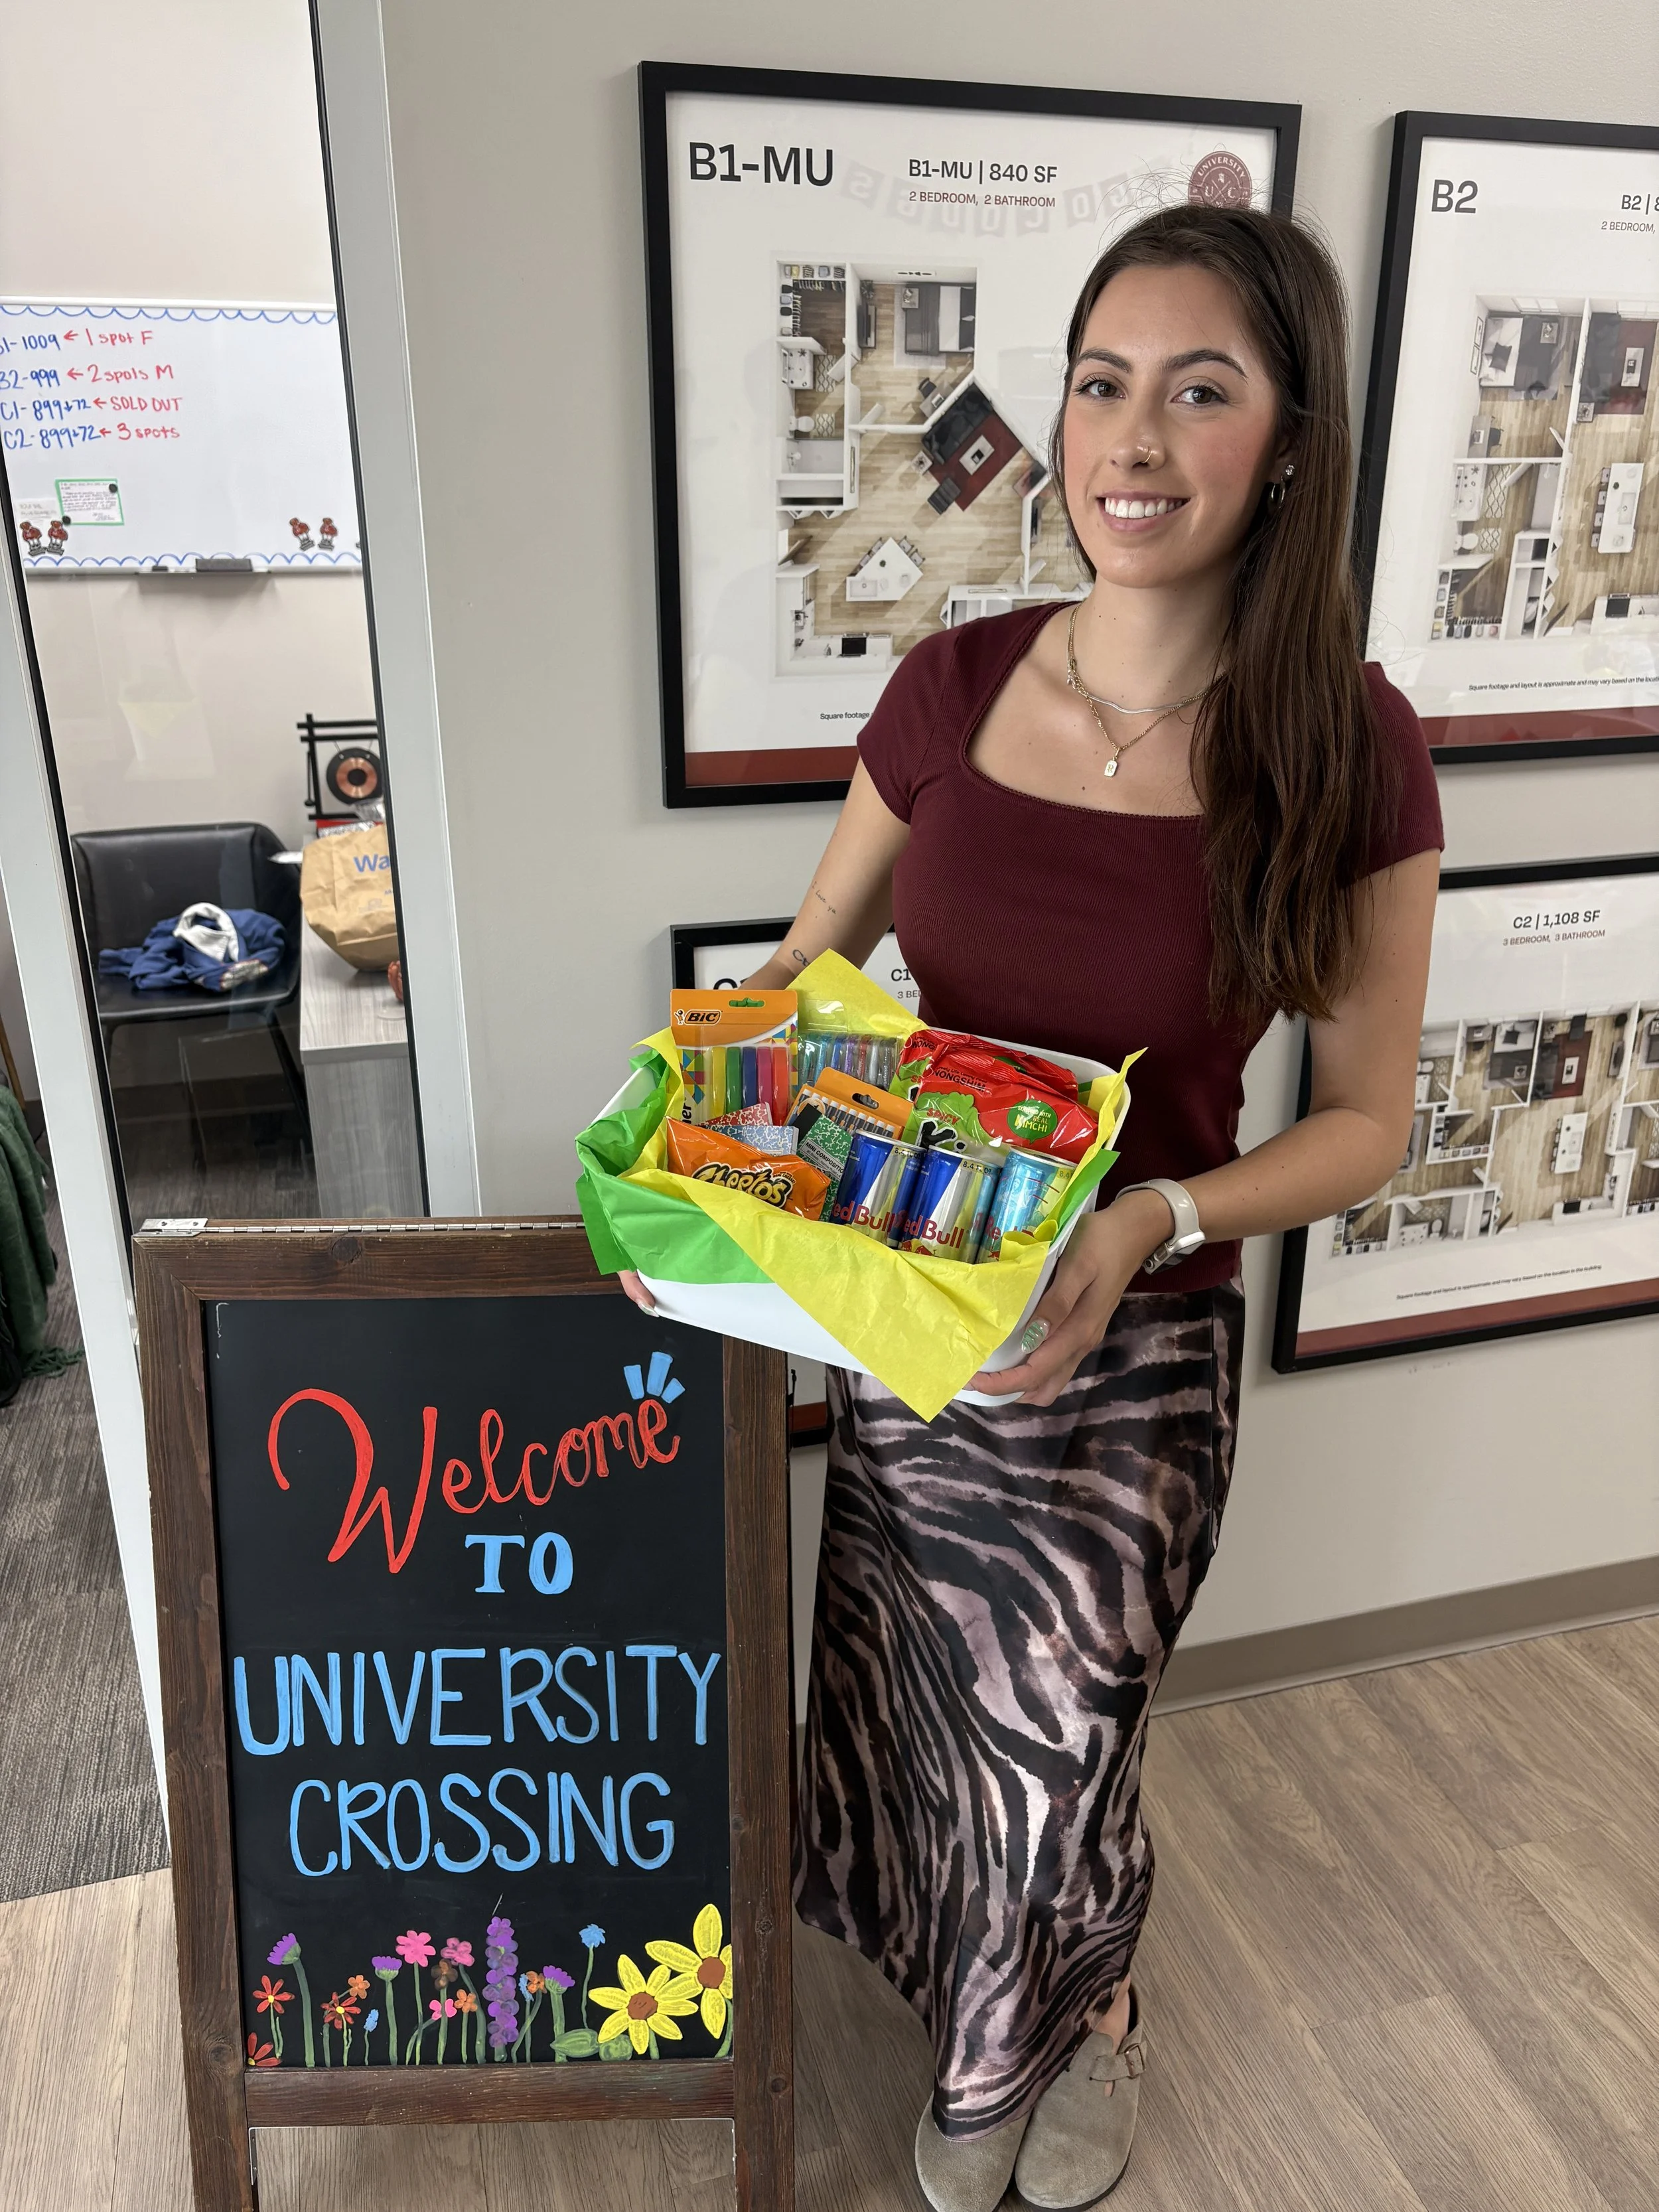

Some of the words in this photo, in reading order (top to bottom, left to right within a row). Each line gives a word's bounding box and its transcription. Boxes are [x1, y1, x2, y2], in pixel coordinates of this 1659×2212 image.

[689, 141, 833, 186] B1-MU
[908, 159, 973, 179] B1-MU
[989, 163, 1028, 182] 840
[1034, 165, 1057, 183] SF
[1197, 156, 1246, 178] UNIVERSITY
[909, 191, 916, 201] 2
[920, 192, 979, 206] BEDROOM,
[984, 194, 991, 204] 2
[995, 195, 1056, 207] BATHROOM
[1431, 179, 1479, 214] B2
[1621, 194, 1642, 210] B2
[1601, 221, 1607, 230] 2
[1609, 222, 1656, 234] BEDROOM,
[99, 332, 135, 346] spot
[141, 331, 153, 345] F
[87, 364, 102, 383] 2
[156, 364, 174, 380] M
[110, 396, 148, 411] SOLD
[152, 398, 182, 412] OUT
[117, 422, 131, 440] 3
[135, 426, 180, 439] spots
[1513, 916, 1532, 929] C2
[1543, 912, 1579, 928] 1,108
[1583, 910, 1601, 922] SF
[1561, 930, 1605, 941] BATHROOM
[891, 968, 911, 982] C1
[926, 1108, 962, 1125] SPICY
[1015, 1114, 1048, 1132] KIMCHI
[805, 1142, 817, 1153] MINI
[963, 1161, 974, 1170] 8.4
[1059, 1170, 1070, 1179] 8.4
[832, 1198, 855, 1221] ed
[854, 1205, 894, 1233] Bull
[922, 1218, 965, 1249] Bull
[268, 1388, 681, 1574] Welcome
[465, 1531, 573, 1595] TO
[234, 1645, 723, 1756] UNIVERSITY
[290, 1767, 675, 1877] CROSSING
